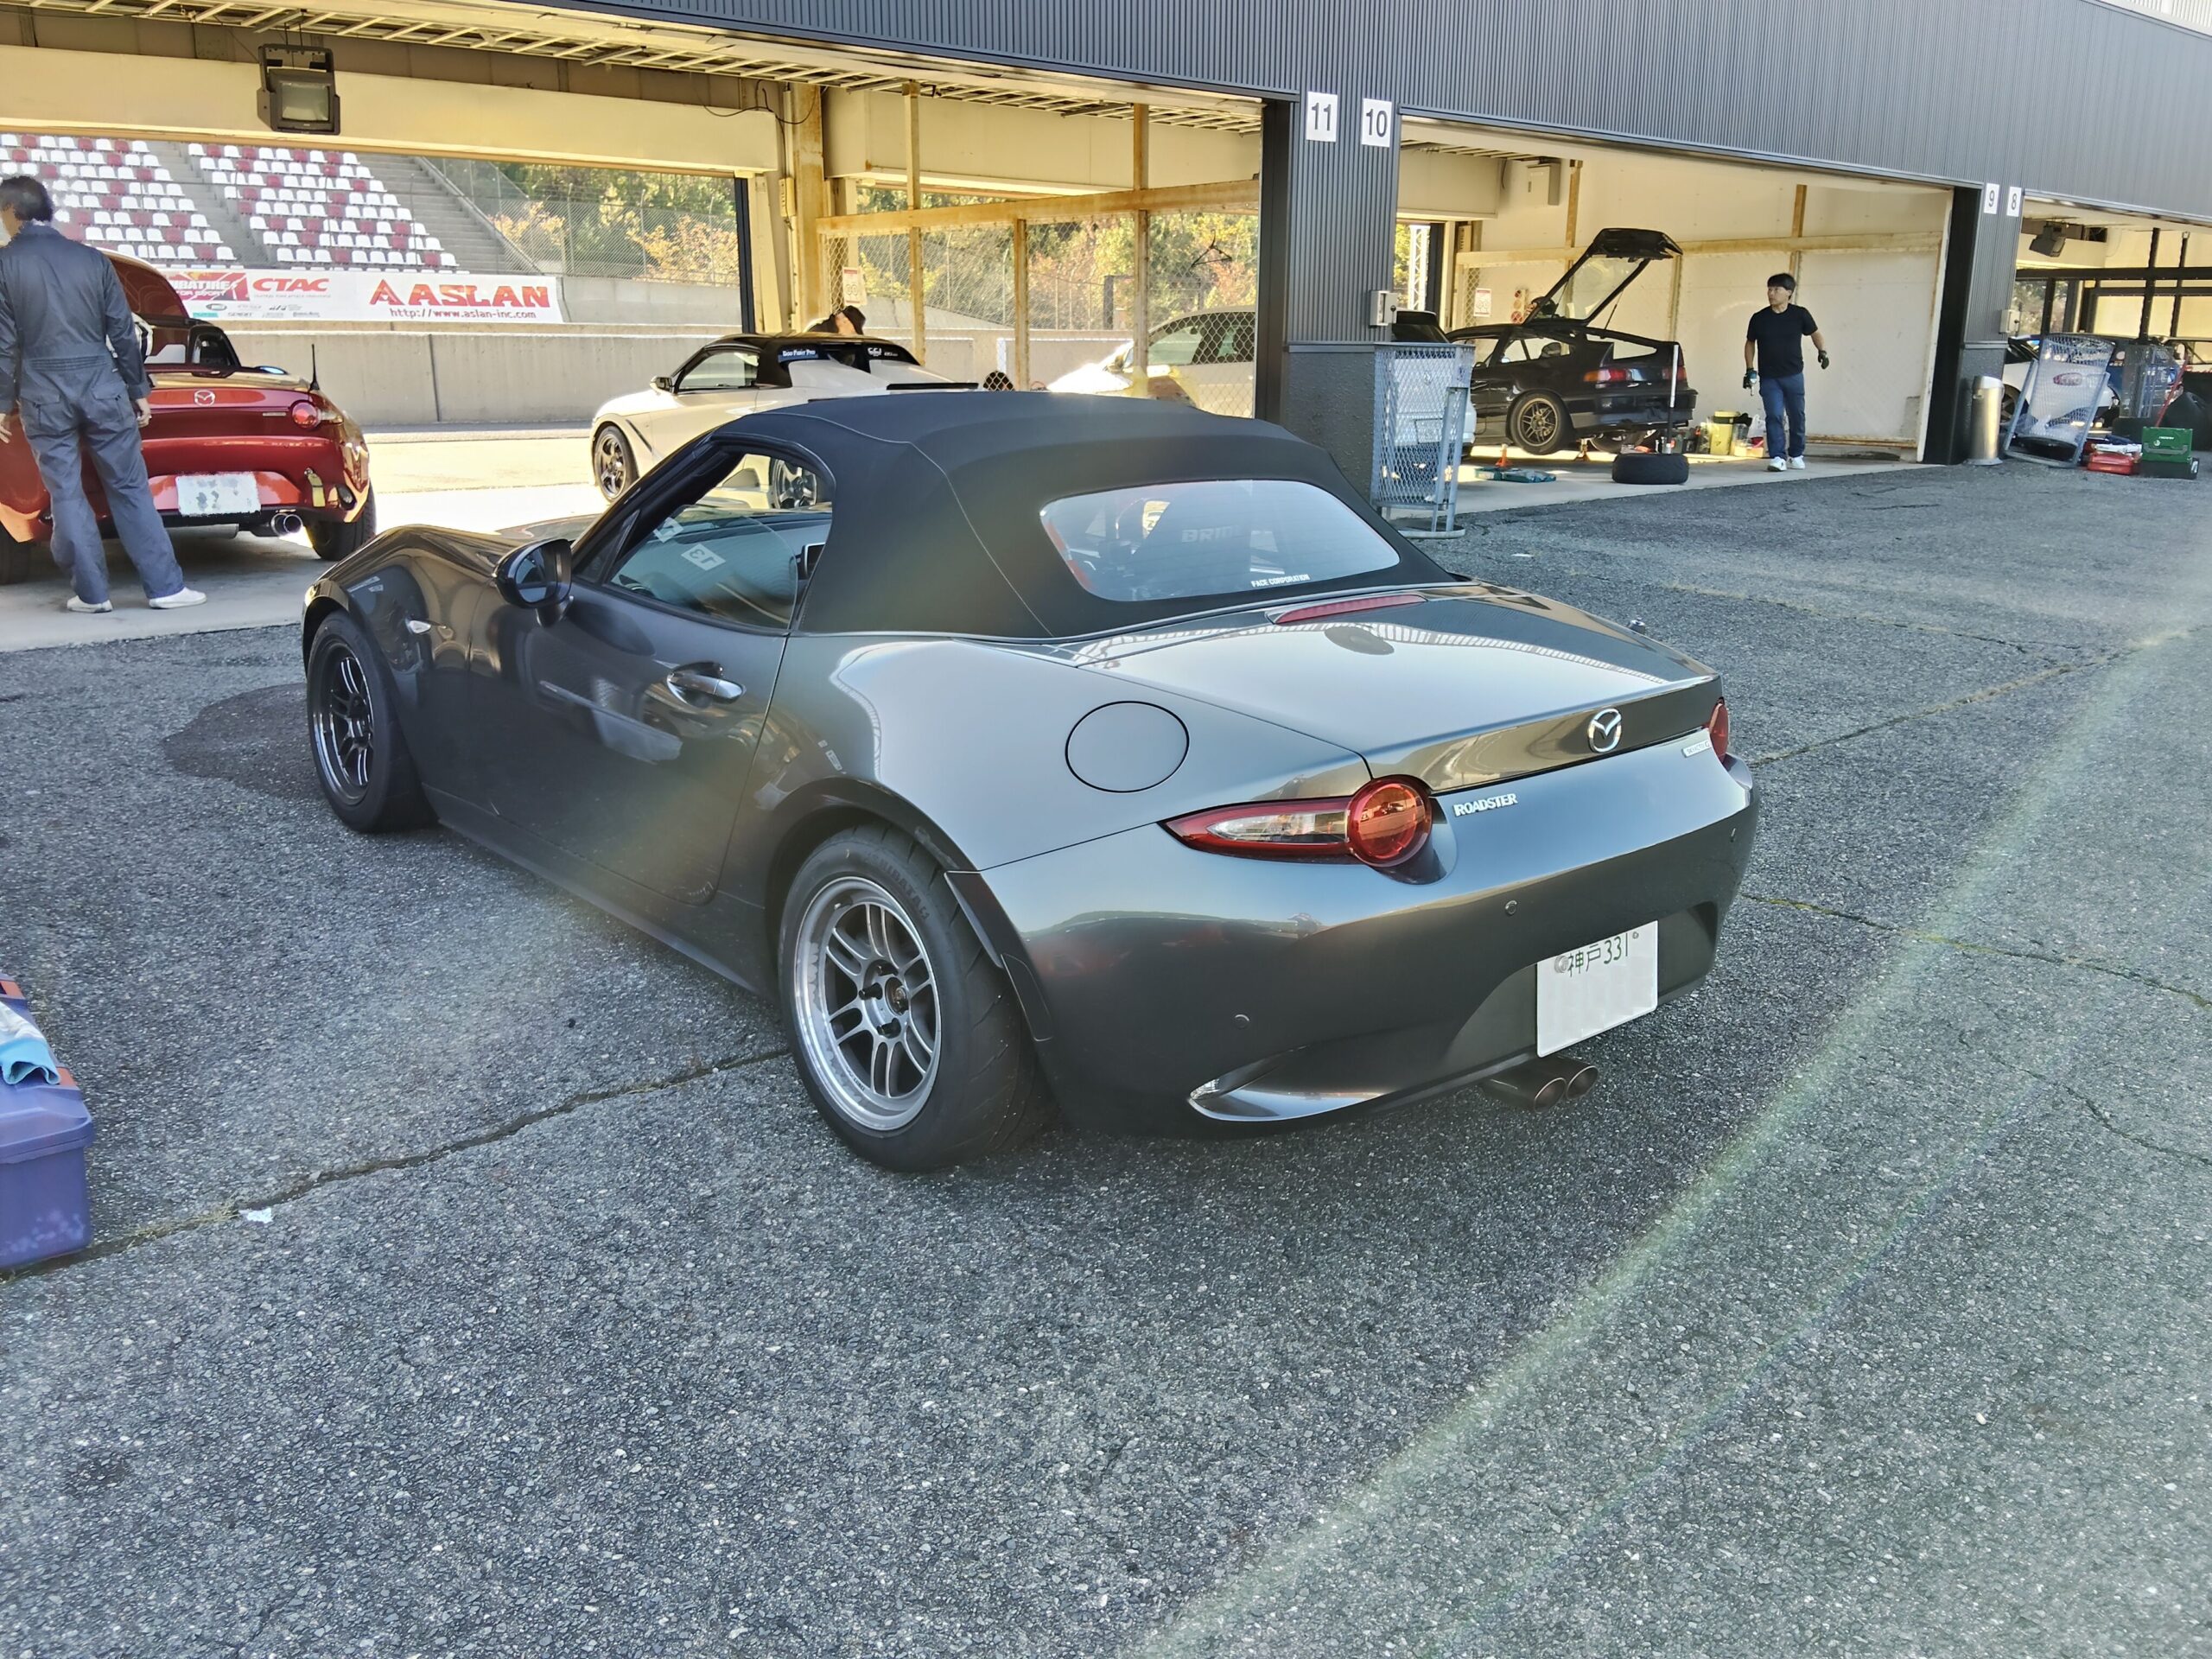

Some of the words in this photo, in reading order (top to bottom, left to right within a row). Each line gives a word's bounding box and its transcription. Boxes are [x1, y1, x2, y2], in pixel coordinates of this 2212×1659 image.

[1311, 102, 1332, 131] 11
[1365, 108, 1388, 137] 10
[1988, 189, 1995, 207] 9
[2011, 193, 2018, 211] 8
[252, 277, 331, 292] CTAC
[408, 283, 550, 308] ASLAN
[390, 308, 537, 320] http://www.aslan-inc.com
[1250, 579, 1269, 588] FACE
[1453, 793, 1518, 817] ROADSTER
